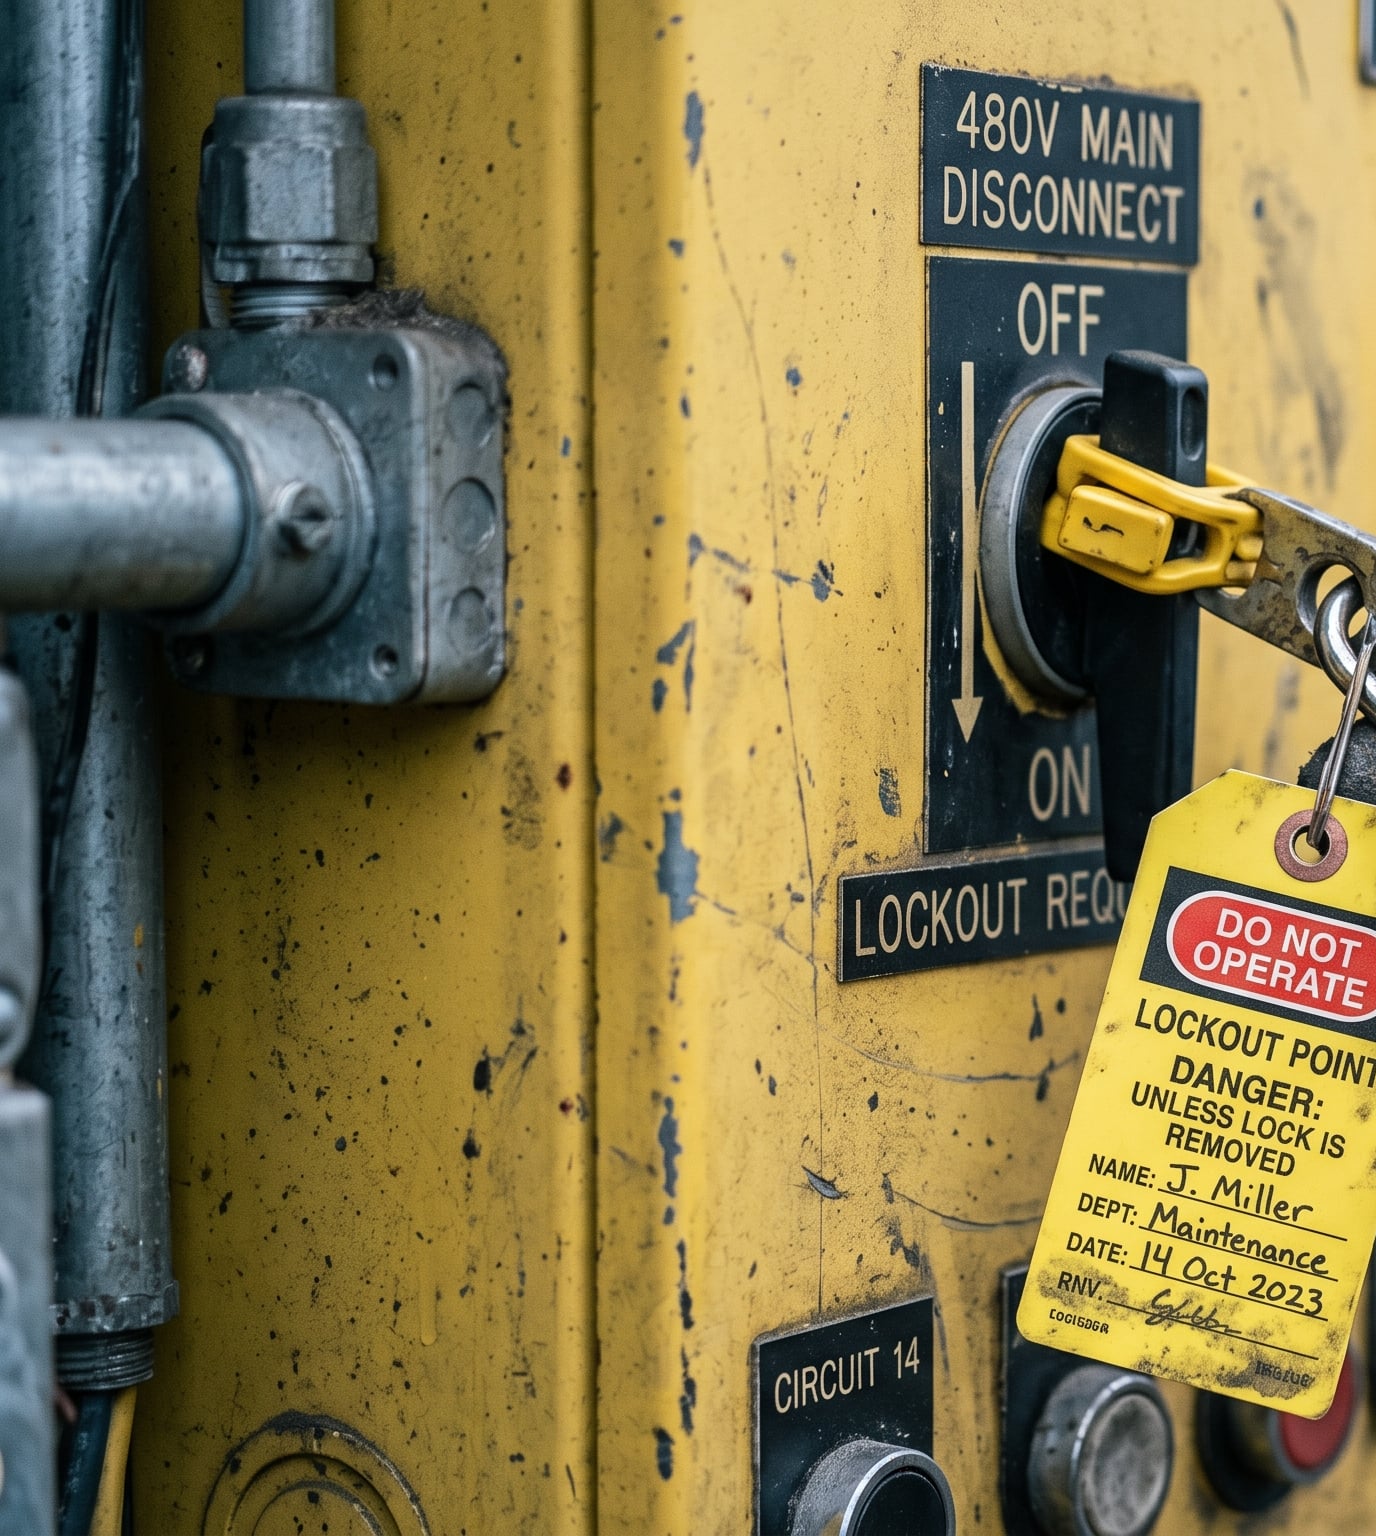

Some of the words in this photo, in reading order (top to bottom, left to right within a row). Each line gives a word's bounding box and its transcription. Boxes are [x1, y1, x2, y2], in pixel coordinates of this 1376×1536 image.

[956, 90, 1060, 157] 480V
[1081, 103, 1174, 171] MAIN
[943, 166, 1185, 244] DISCONNECT
[1017, 281, 1105, 356] OFF
[1028, 744, 1091, 821] ON
[855, 878, 1028, 957] LOCKOUT
[1215, 907, 1272, 947] DO
[1281, 924, 1362, 969] NOT
[1193, 940, 1368, 1010] OPERATE
[1134, 998, 1284, 1062] LOCKOUT
[1131, 1081, 1235, 1130] UNLESS
[1240, 1110, 1316, 1151] LOCK
[1319, 1131, 1346, 1159] IS
[1169, 1054, 1325, 1120] DANGER:
[1088, 1153, 1157, 1189] NAME:
[1165, 1122, 1296, 1177] REMOVED
[1077, 1192, 1138, 1226] DEPT:
[1166, 1163, 1200, 1196] J.
[1211, 1175, 1314, 1222] Miller
[1066, 1231, 1128, 1266] DATE:
[1148, 1201, 1330, 1276] Maintenance
[1140, 1240, 1174, 1275] 14
[1182, 1256, 1237, 1292] Oct
[1247, 1273, 1324, 1316] 2023
[774, 1346, 880, 1414] CIRCUIT
[893, 1335, 921, 1380] 14
